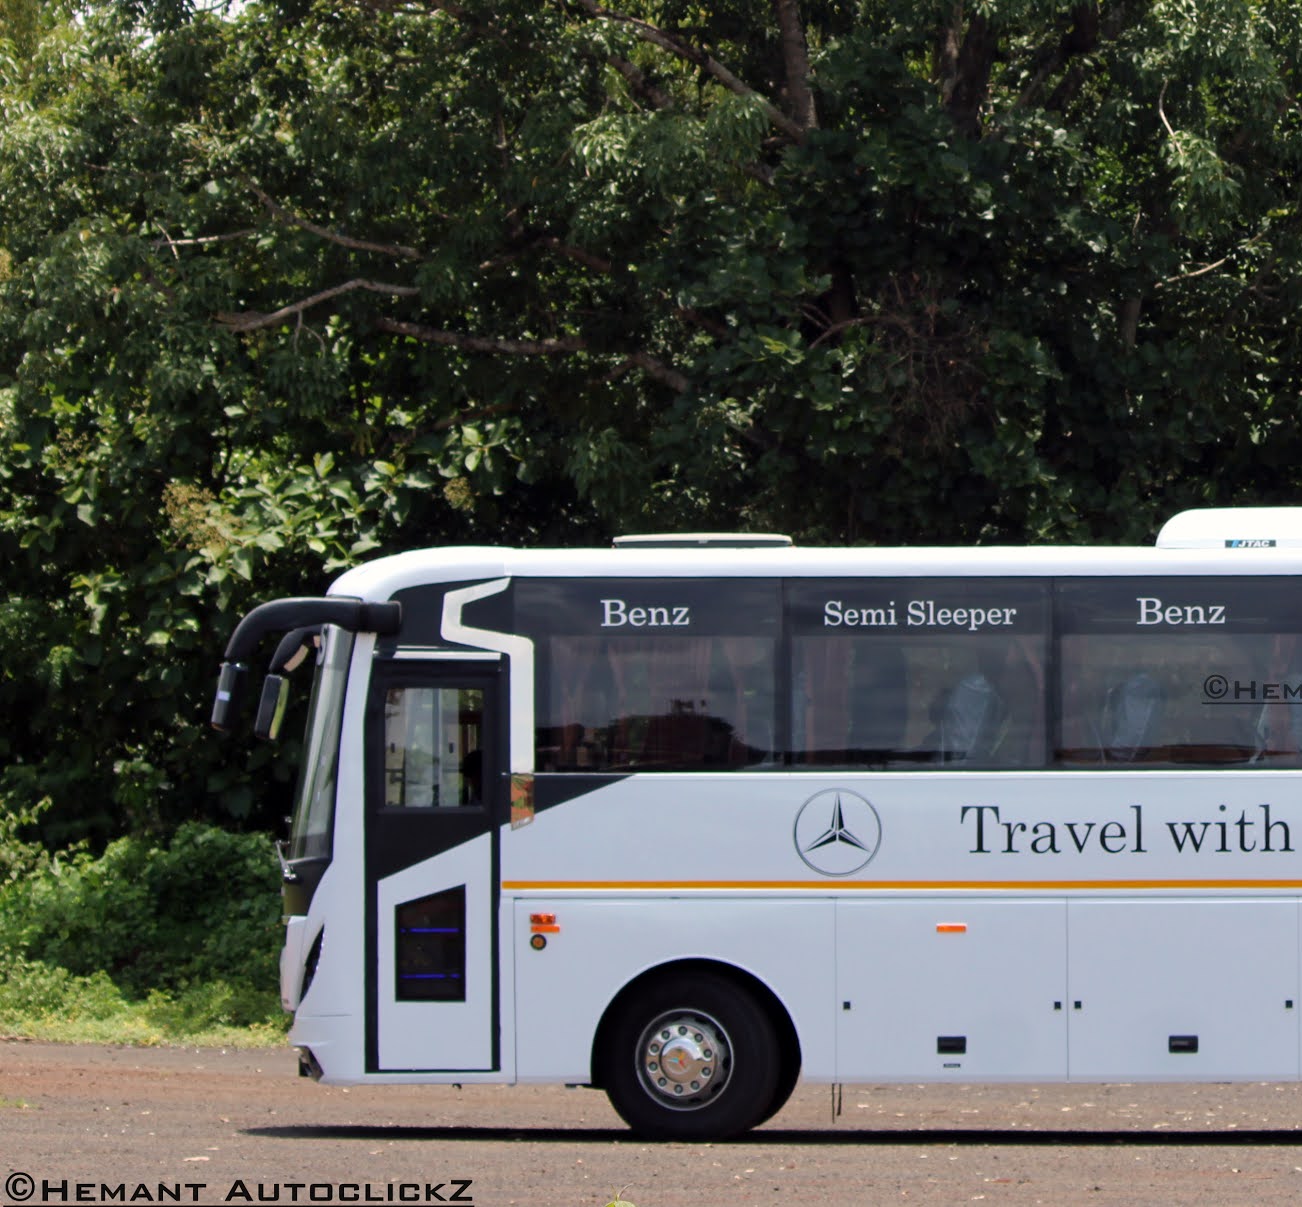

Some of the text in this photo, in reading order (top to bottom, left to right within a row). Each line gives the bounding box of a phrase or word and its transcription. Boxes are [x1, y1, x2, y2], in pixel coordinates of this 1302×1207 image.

[1238, 539, 1270, 548] JTAC
[600, 599, 690, 627] Benz
[824, 600, 1017, 633] Semi Sleeper
[1136, 597, 1226, 625] Benz
[960, 805, 1147, 854] Travel
[1165, 804, 1295, 853] with
